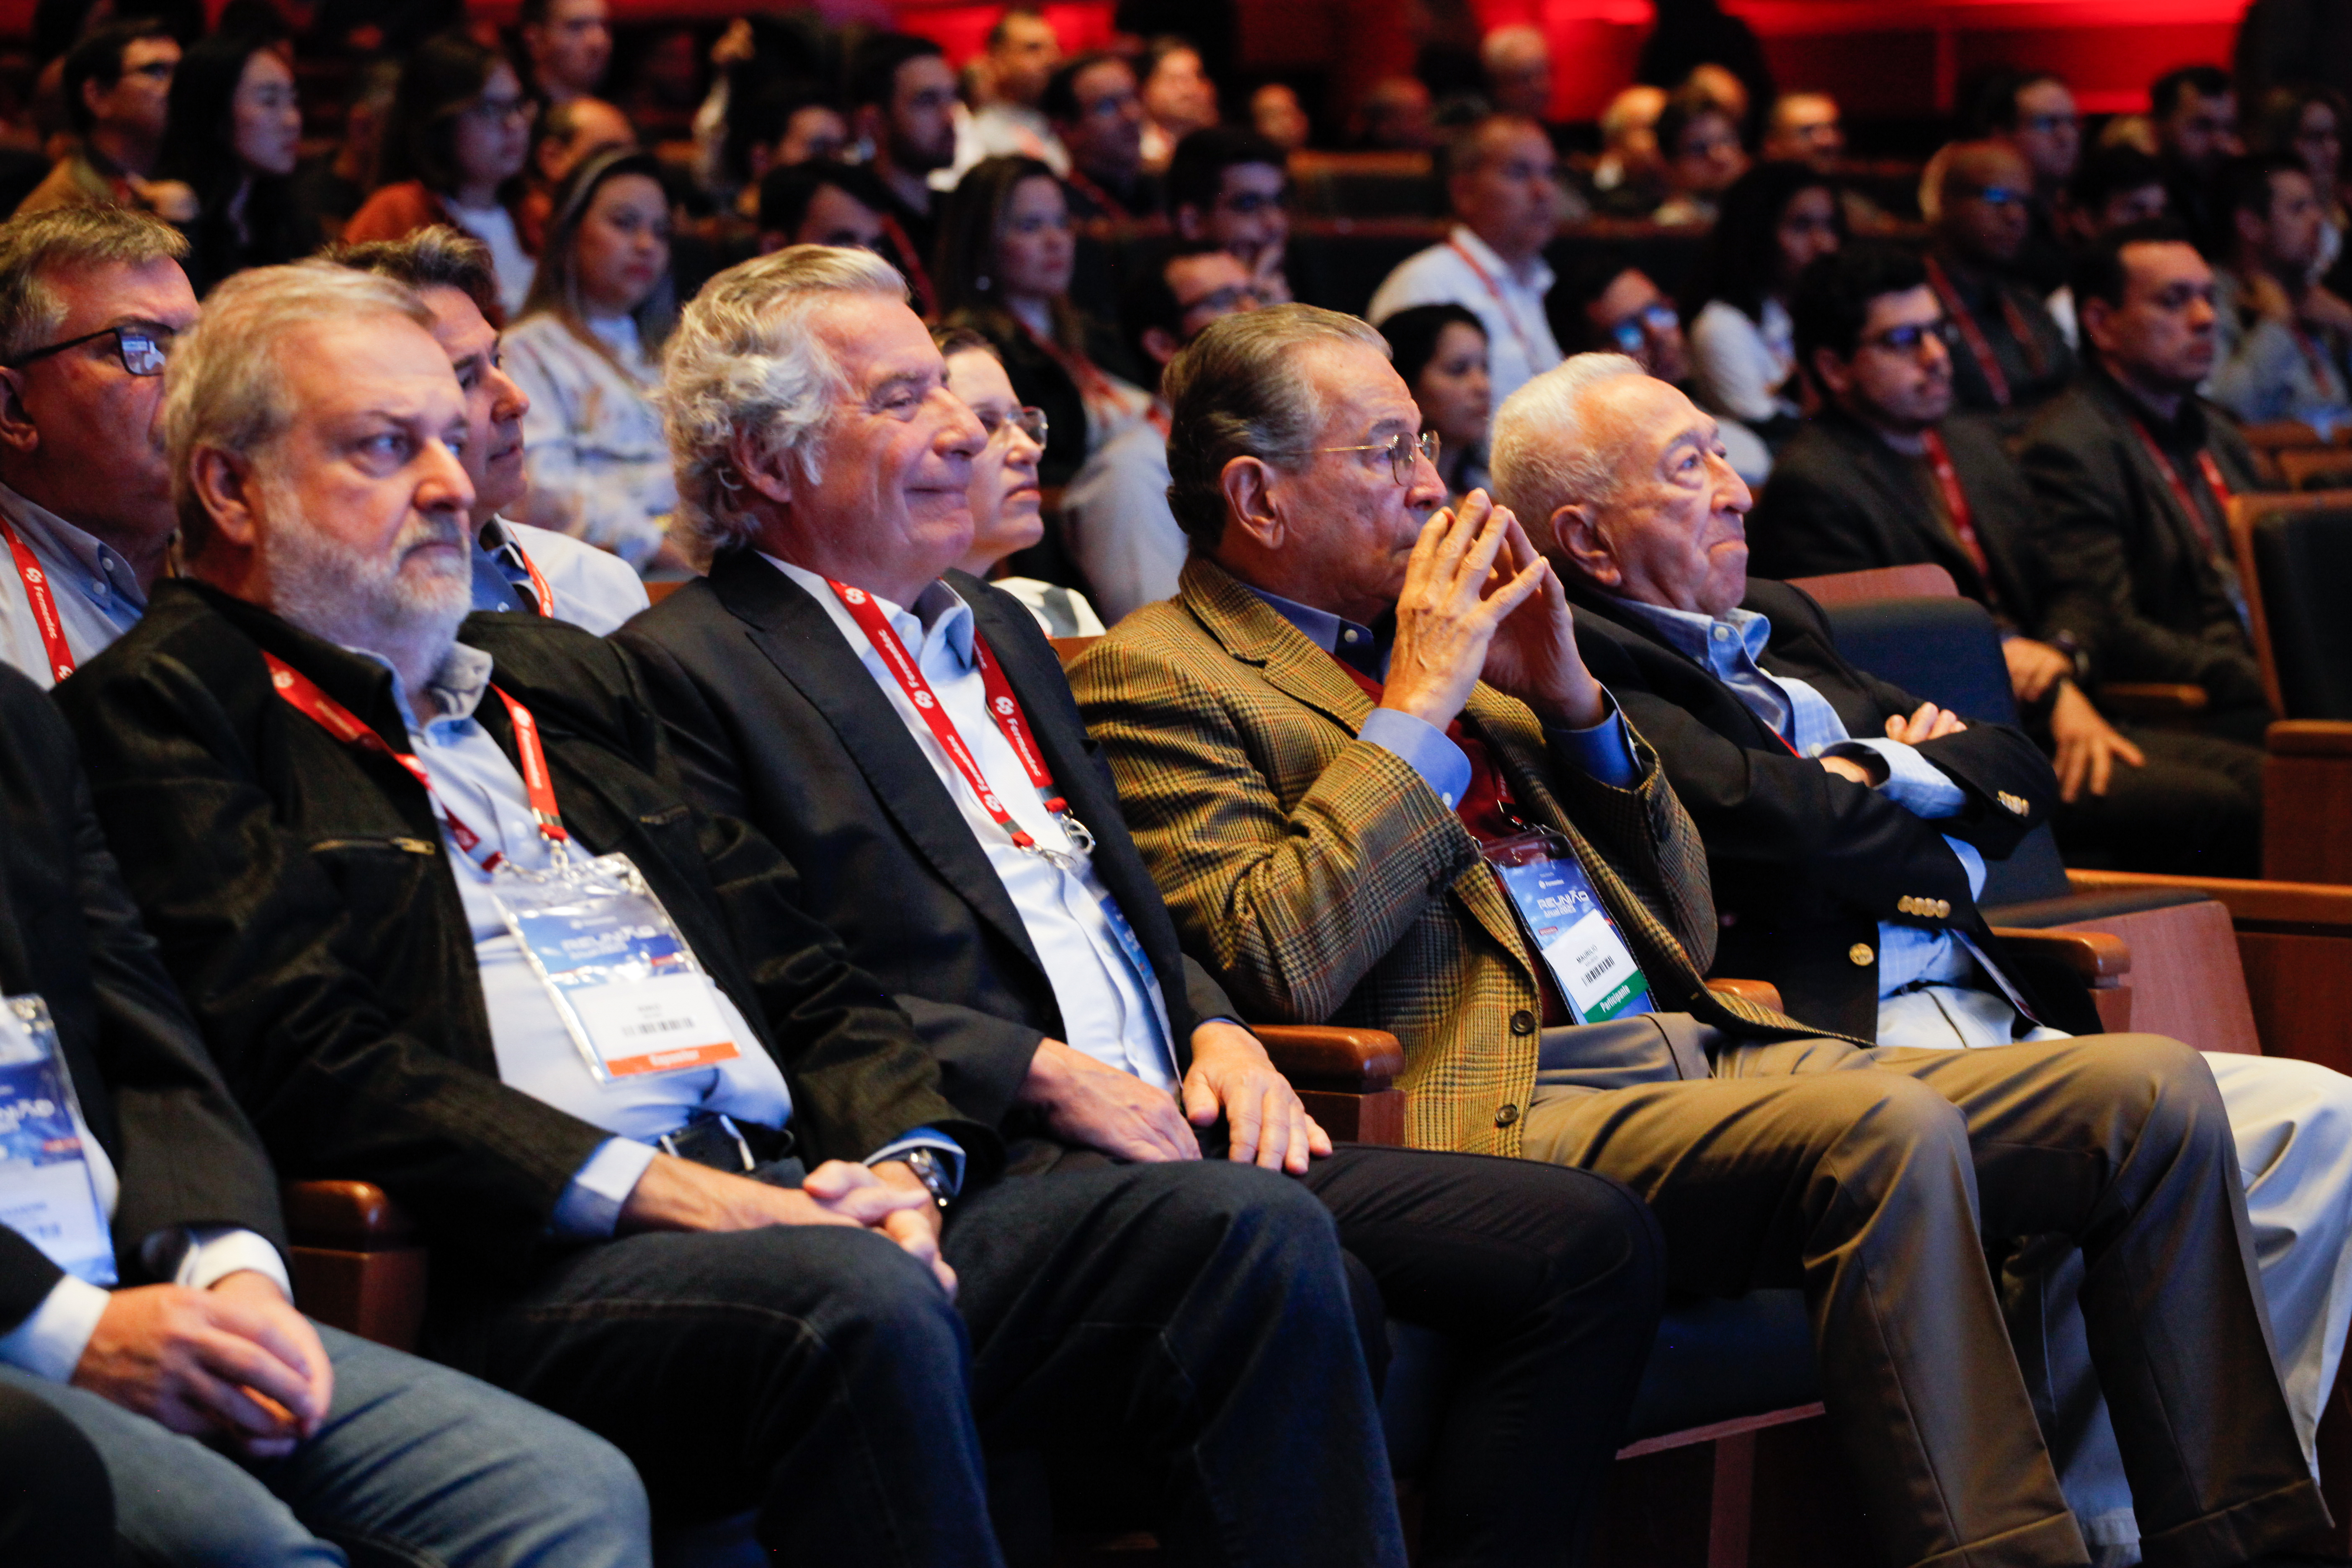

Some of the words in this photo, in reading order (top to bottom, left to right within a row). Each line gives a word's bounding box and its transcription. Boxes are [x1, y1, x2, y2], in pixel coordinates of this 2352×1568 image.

[33, 585, 58, 640] Fermentec
[878, 629, 920, 688] Fermentec
[946, 734, 990, 792] Fermentec
[1007, 718, 1042, 777] Fermentec
[1537, 890, 1590, 910] REUNIÃO
[1599, 985, 1631, 1013] Participante
